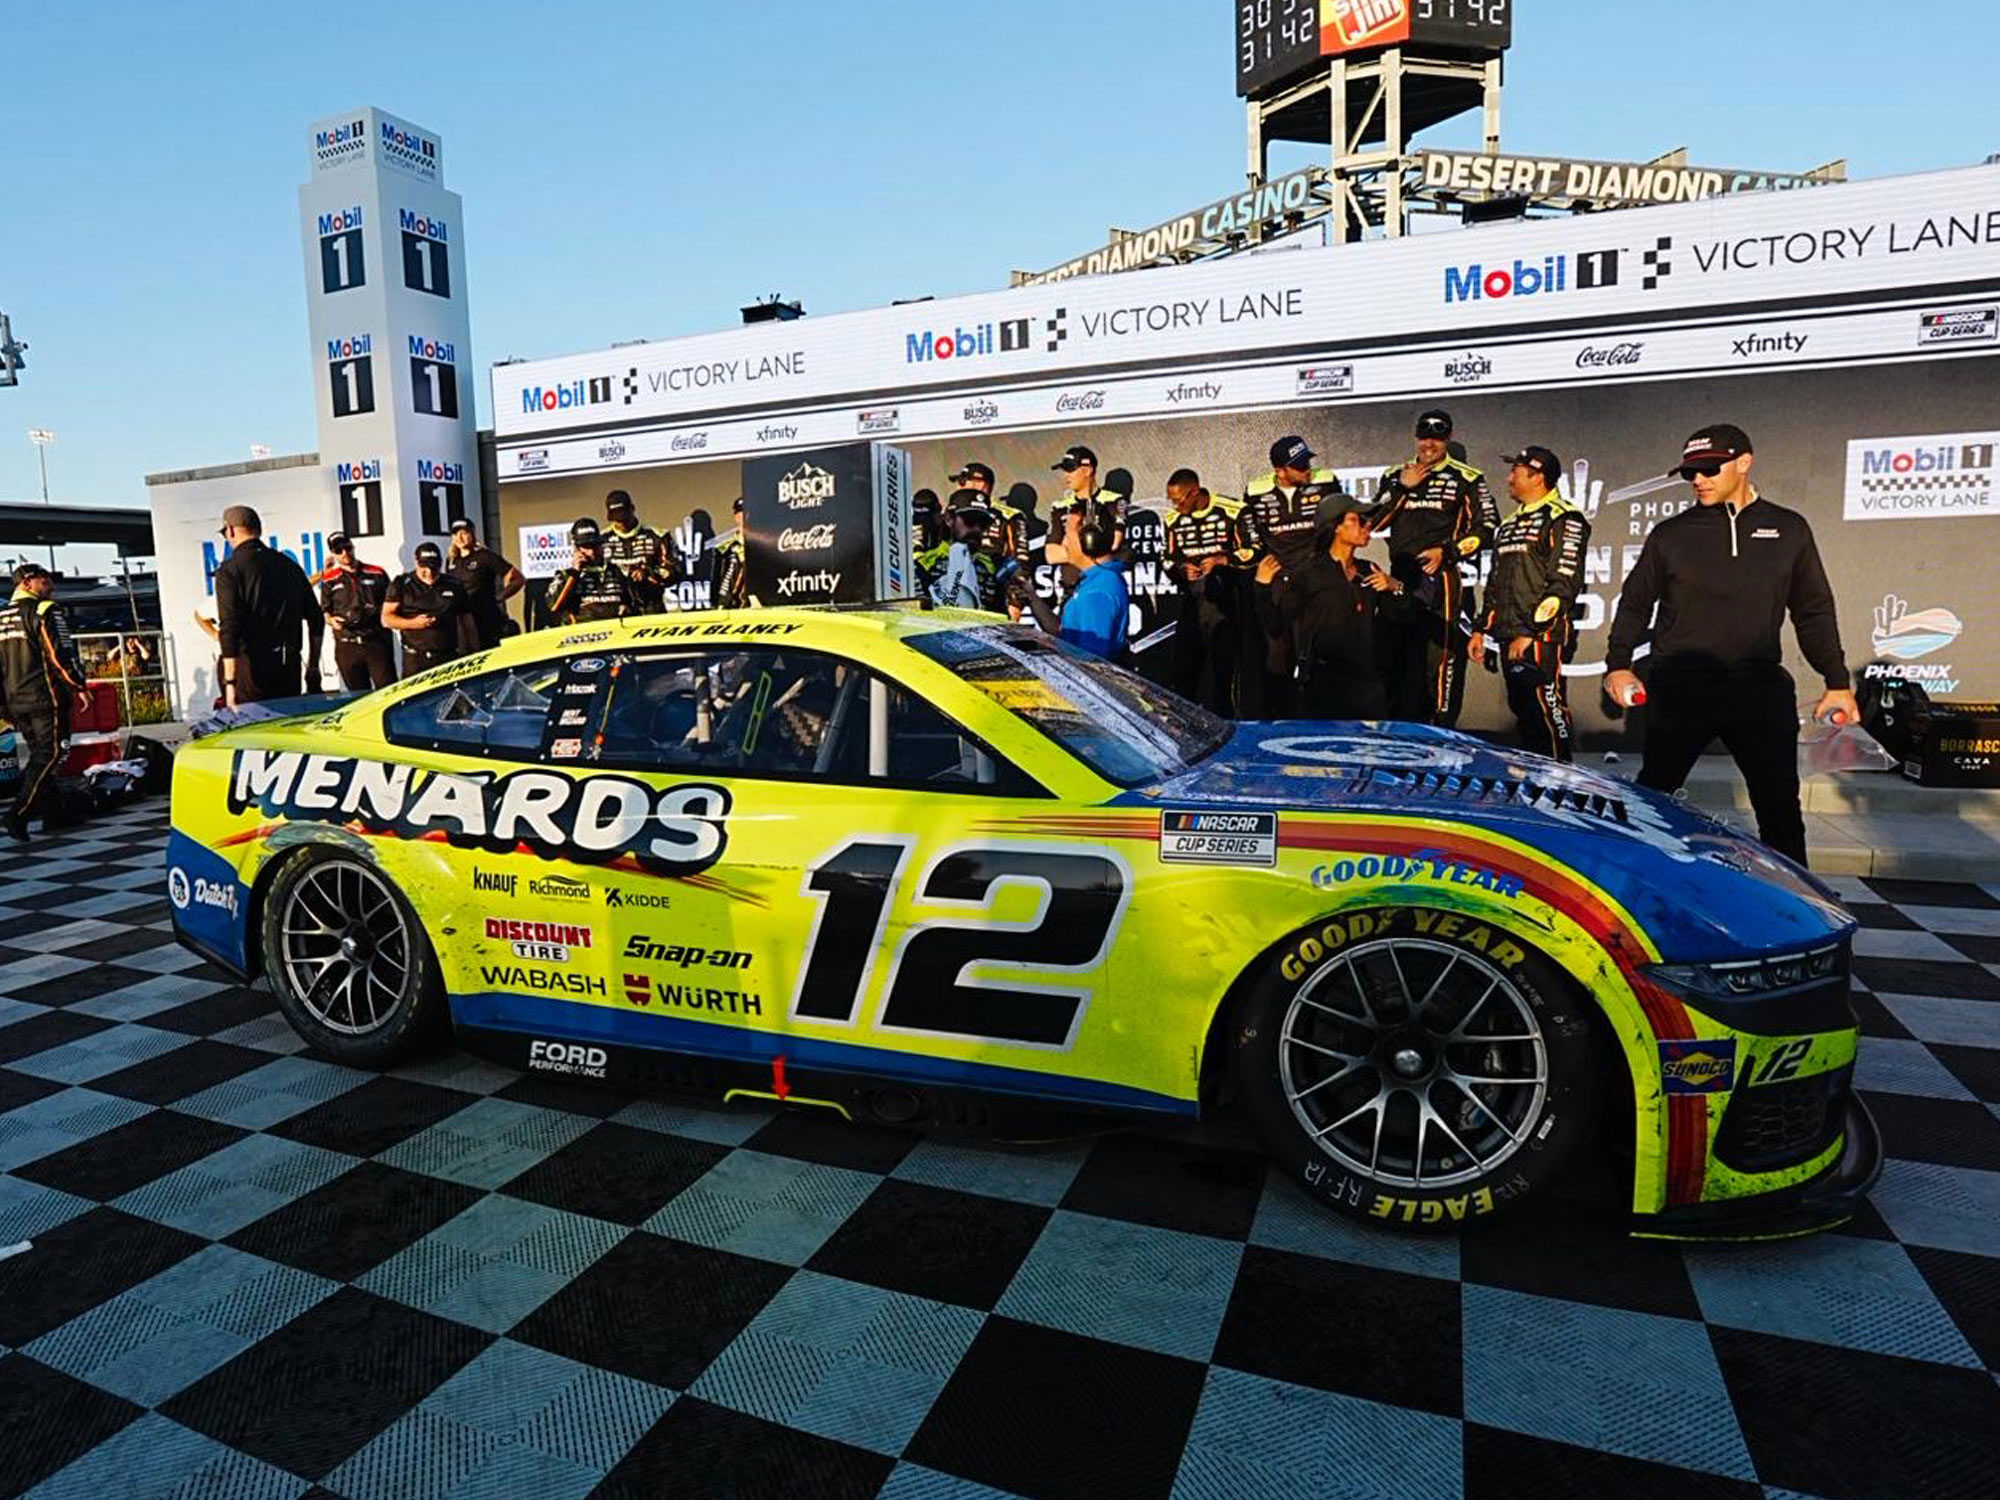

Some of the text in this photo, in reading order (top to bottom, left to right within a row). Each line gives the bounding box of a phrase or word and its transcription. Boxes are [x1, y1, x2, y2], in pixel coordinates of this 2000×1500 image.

[1281, 8, 1314, 46] 42
[316, 125, 350, 149] Mobil
[382, 122, 420, 151] Mobil
[1425, 153, 1560, 193] DESERT
[1566, 163, 1722, 201] DIAMOND
[1201, 174, 1307, 238] CASINO
[318, 206, 362, 235] Mobil
[399, 208, 447, 241] Mobil
[1087, 217, 1195, 275] DIAMOND
[1444, 255, 1566, 301] Mobil
[1692, 225, 1876, 272] VICTORY
[1890, 210, 2000, 253] LANE
[905, 323, 992, 363] Mobil
[1081, 299, 1209, 338] VICTORY
[1219, 289, 1302, 323] LANE
[328, 333, 371, 360] Mobil
[408, 335, 455, 362] Mobil
[1732, 331, 1808, 357] xfinity
[521, 381, 584, 413] Mobil
[648, 361, 738, 392] VICTORY
[745, 352, 805, 380] LANE
[1444, 360, 1492, 378] BUSCH
[1166, 382, 1222, 403] xfinity
[963, 405, 998, 420] BUSCH
[756, 425, 798, 442] xfinity
[599, 445, 626, 458] BUSCH
[1863, 446, 1955, 474] Mobil
[338, 460, 381, 483] Mobil
[417, 459, 464, 482] Mobil
[777, 475, 836, 503] BUSCH
[886, 451, 899, 527] SERIES
[1861, 491, 1990, 510] VICTORY LANE
[789, 497, 824, 510] LIGHT
[888, 530, 901, 571] CUP
[777, 569, 841, 597] xfinity
[631, 623, 804, 639] RYAN BLANEY
[1864, 664, 1953, 679] PHOENIX
[229, 750, 732, 874] MENARDS
[1195, 815, 1260, 833] NASCAR
[1175, 836, 1260, 855] CUP SERIES
[473, 866, 518, 898] KNAUF
[529, 879, 591, 899] Richmond
[624, 893, 670, 909] KIDDE
[485, 917, 592, 949] DISCOUNT
[787, 830, 1134, 1054] 12
[516, 944, 564, 961] TIRE
[623, 935, 754, 970] Snap-on
[481, 966, 607, 996] WABASH
[657, 983, 762, 1016] WÜRTH
[530, 1040, 607, 1067] FORD
[1754, 1037, 1814, 1083] 12
[528, 1058, 607, 1079] PERFORMANCE
[1662, 1059, 1731, 1078] SUNOCO
[1368, 1185, 1497, 1223] EAGLE
